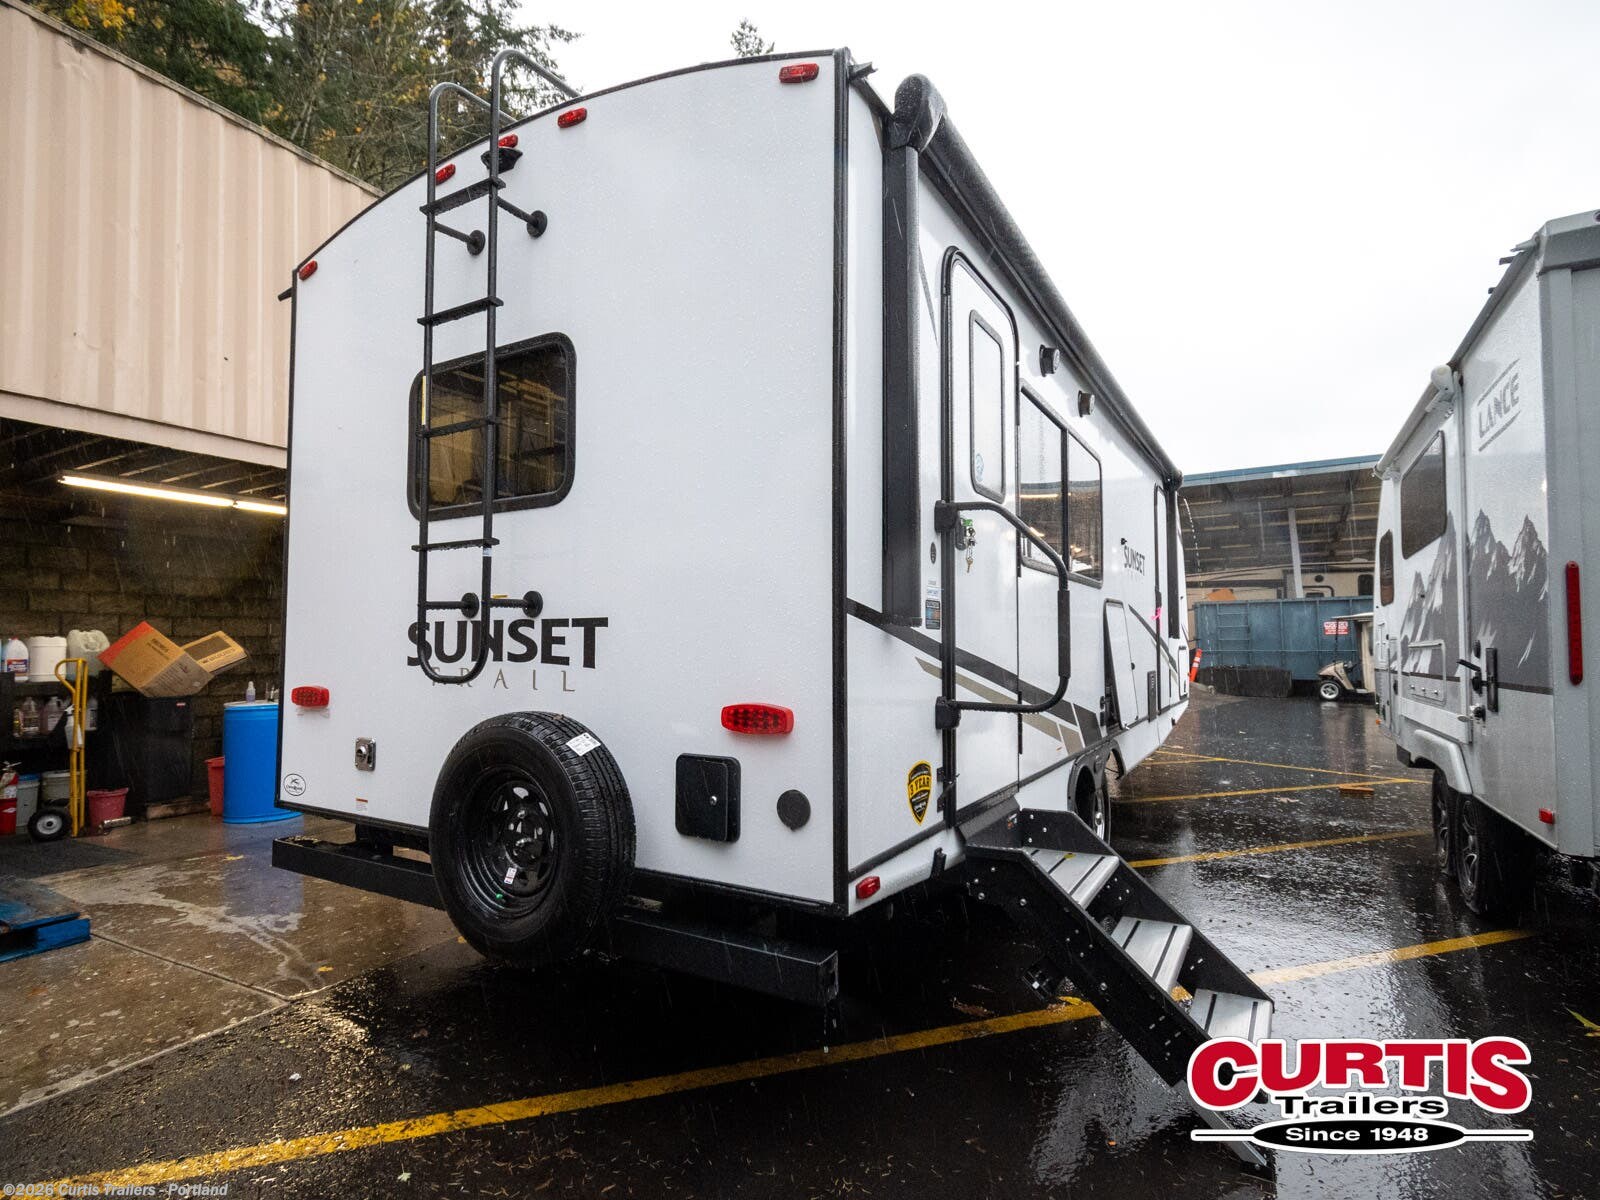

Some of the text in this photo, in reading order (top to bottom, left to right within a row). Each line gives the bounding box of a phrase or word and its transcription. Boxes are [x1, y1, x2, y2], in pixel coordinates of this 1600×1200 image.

[1479, 372, 1519, 438] LANCE
[1123, 545, 1145, 576] SUNSET
[407, 617, 608, 669] SUNSET
